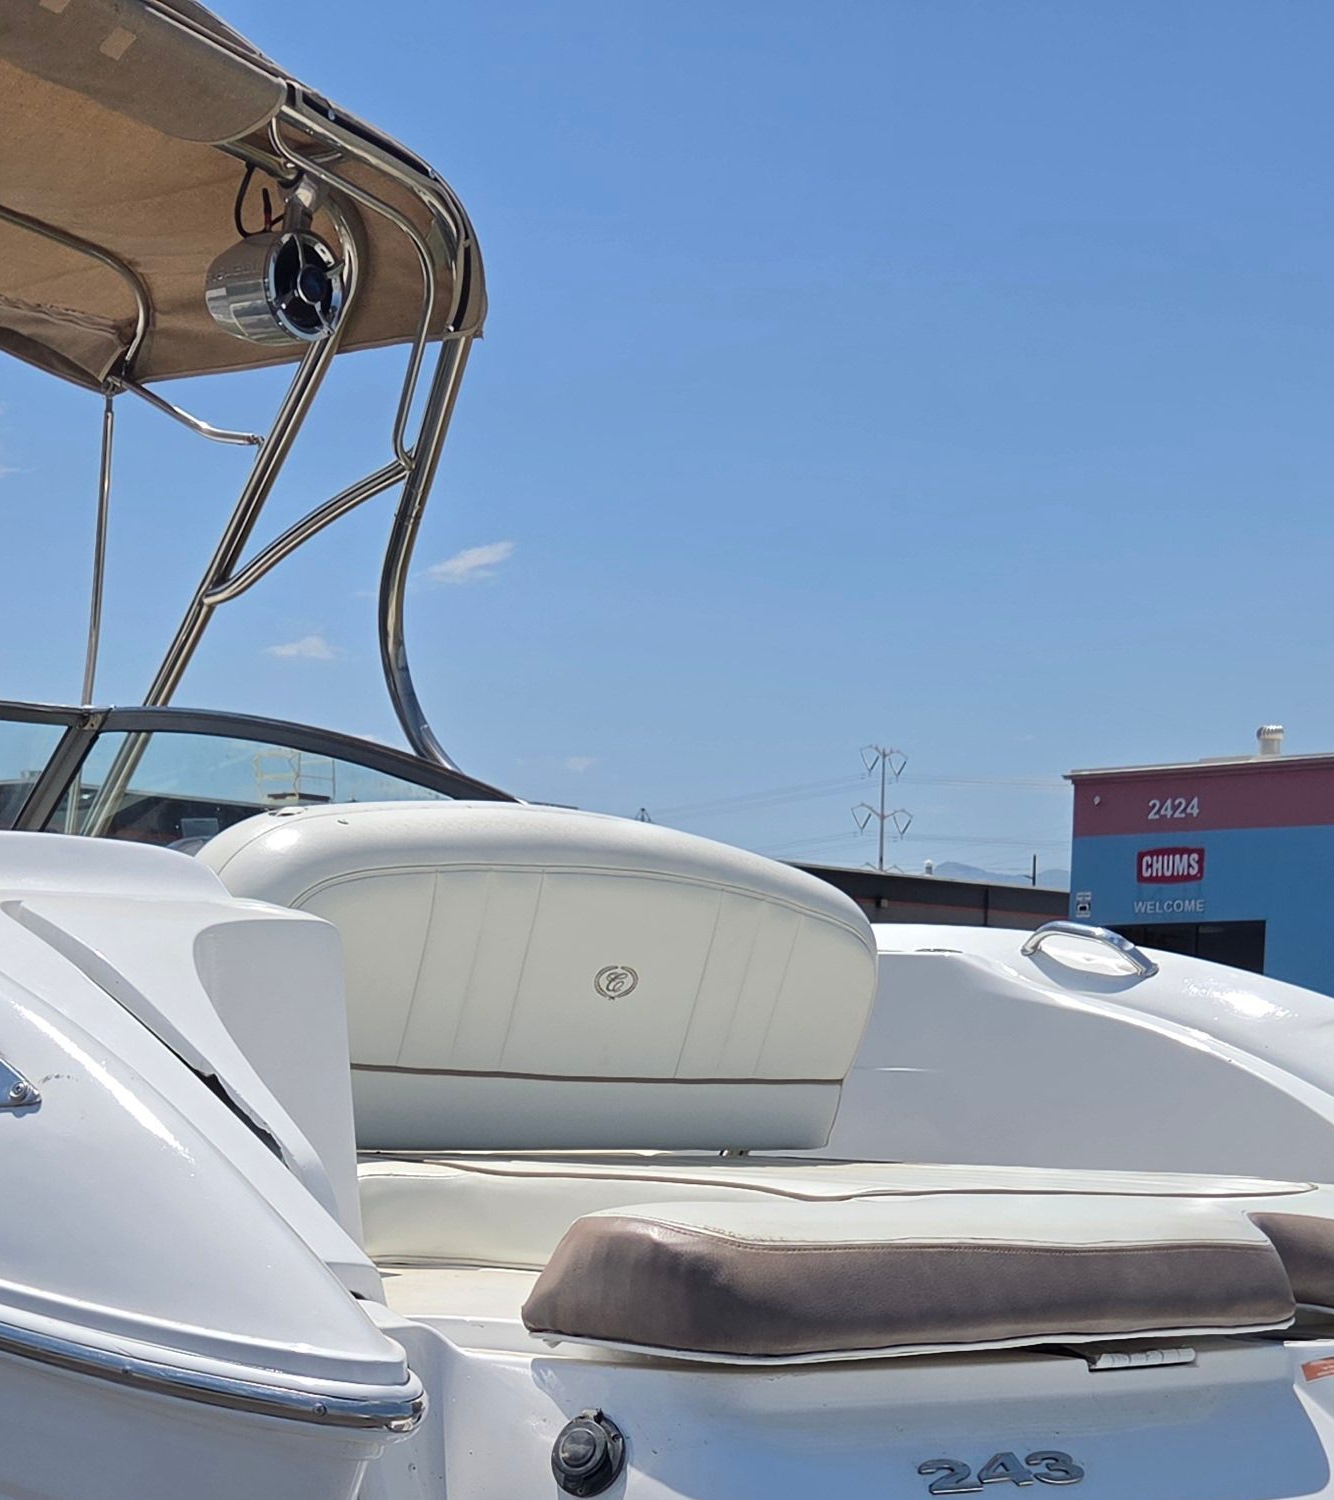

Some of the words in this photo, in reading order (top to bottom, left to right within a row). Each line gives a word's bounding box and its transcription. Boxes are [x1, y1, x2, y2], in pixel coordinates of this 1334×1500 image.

[1147, 797, 1199, 819] 2424
[1141, 853, 1200, 877] CHUMS
[1134, 900, 1205, 913] WELCOME
[918, 1451, 1084, 1494] 243
